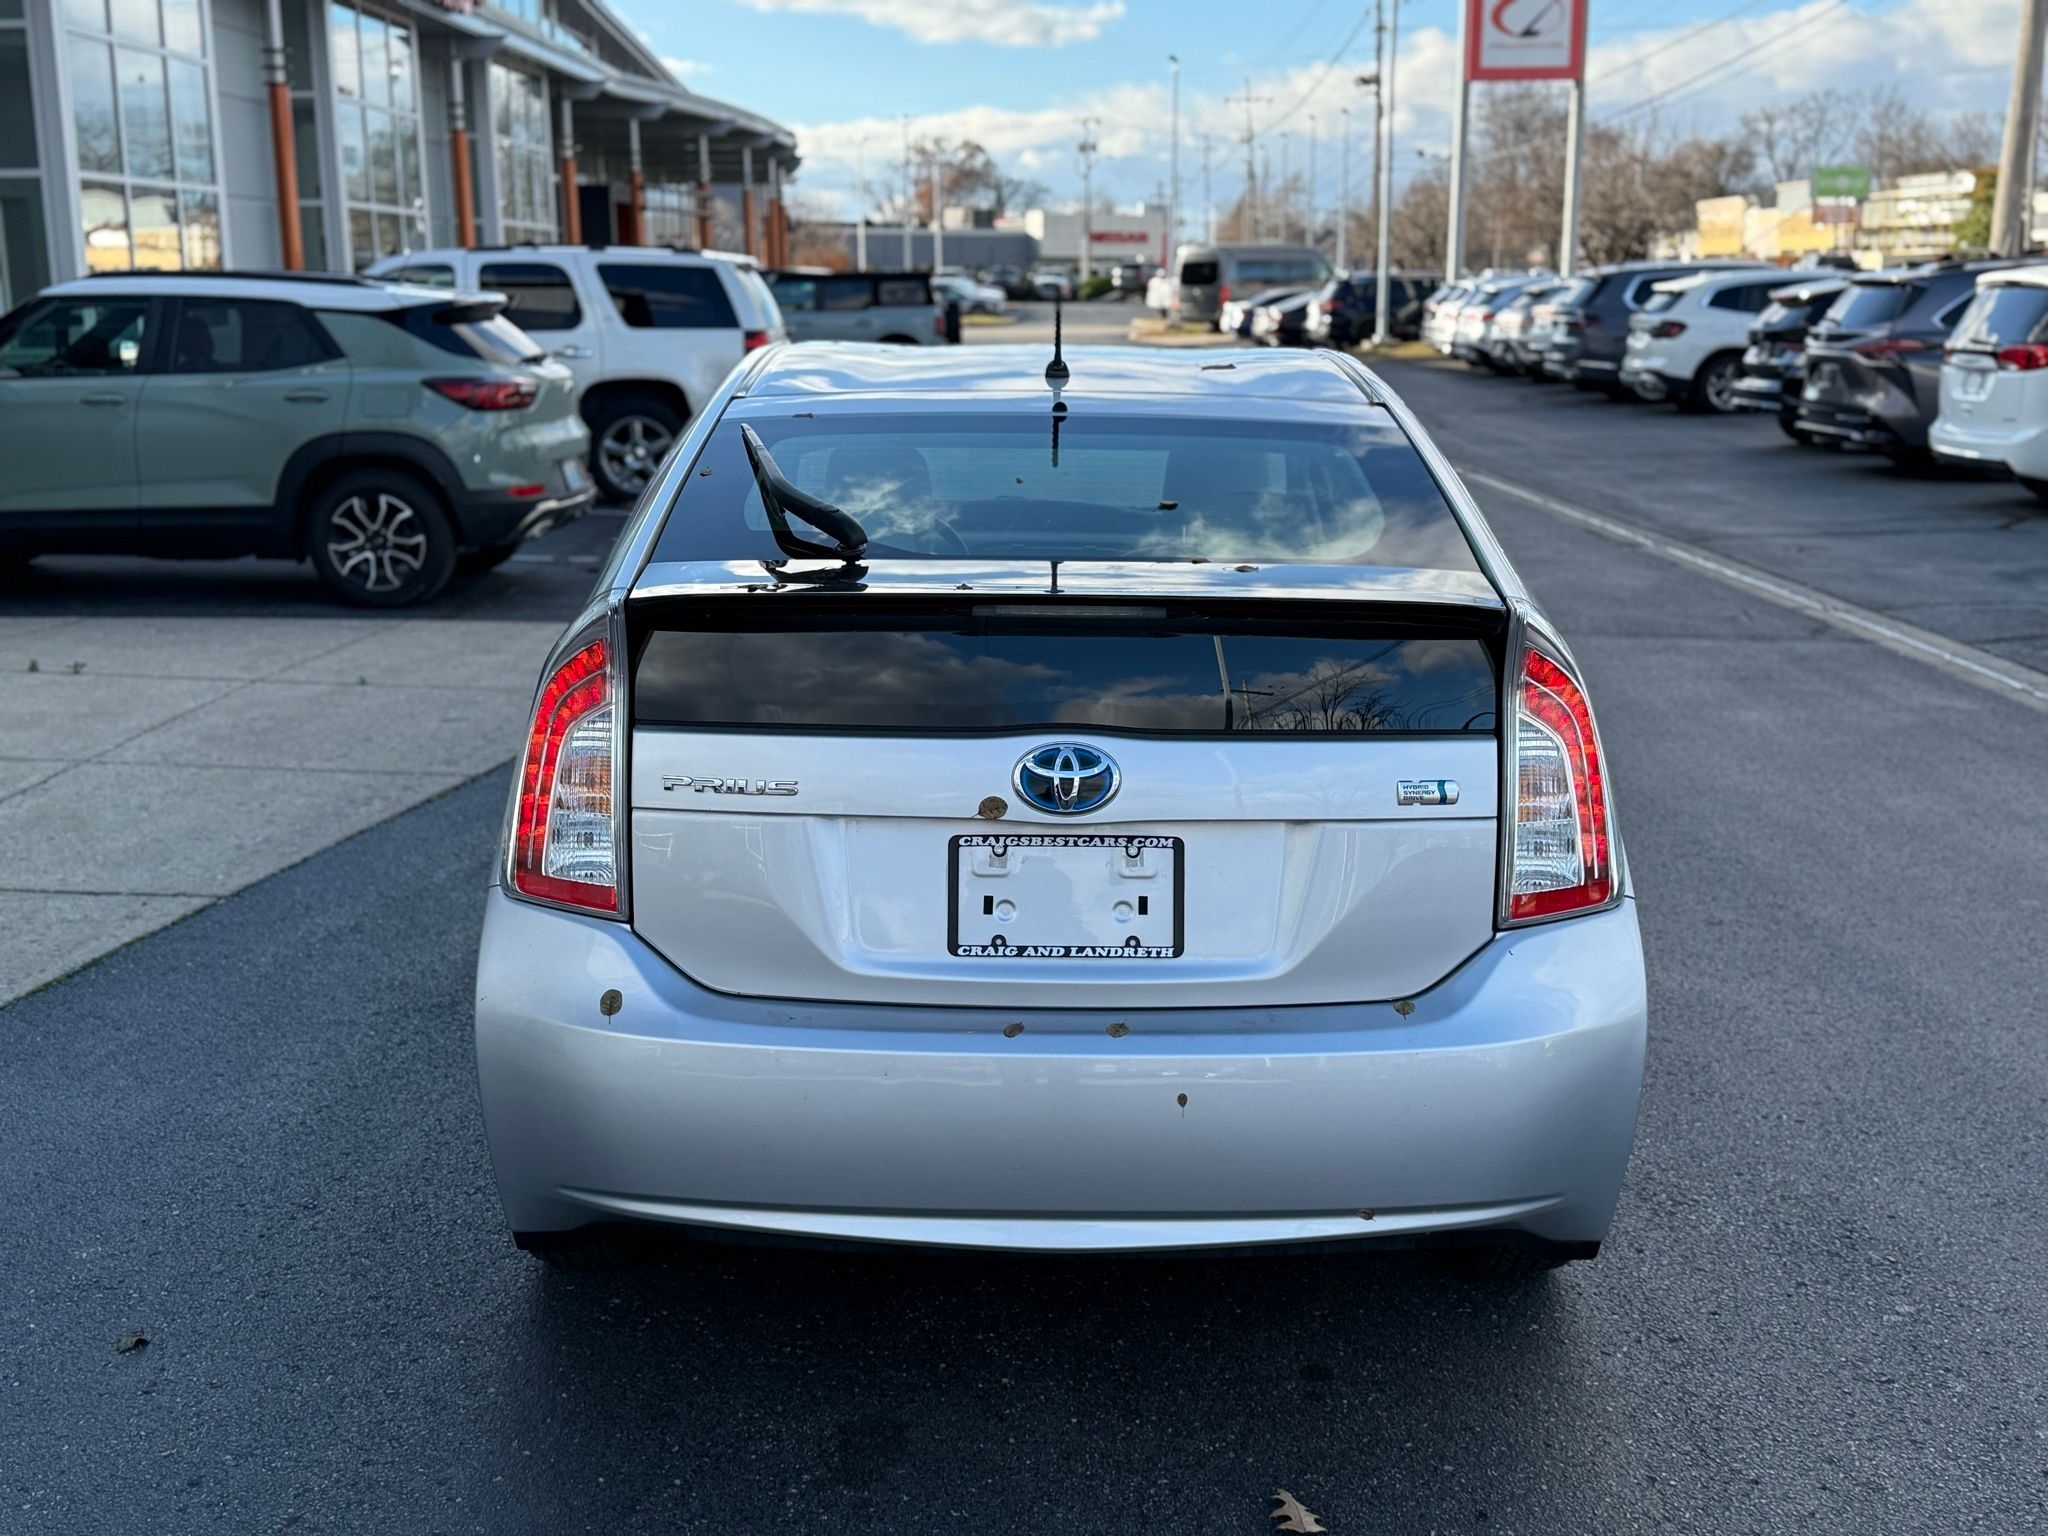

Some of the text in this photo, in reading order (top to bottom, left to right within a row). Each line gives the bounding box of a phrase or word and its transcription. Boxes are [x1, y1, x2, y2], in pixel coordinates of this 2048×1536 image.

[662, 775, 799, 796] PRIUS
[957, 836, 1174, 847] CRAIGSBESTCARS.COM
[957, 946, 1174, 958] CRAIG AND LANDRETH
